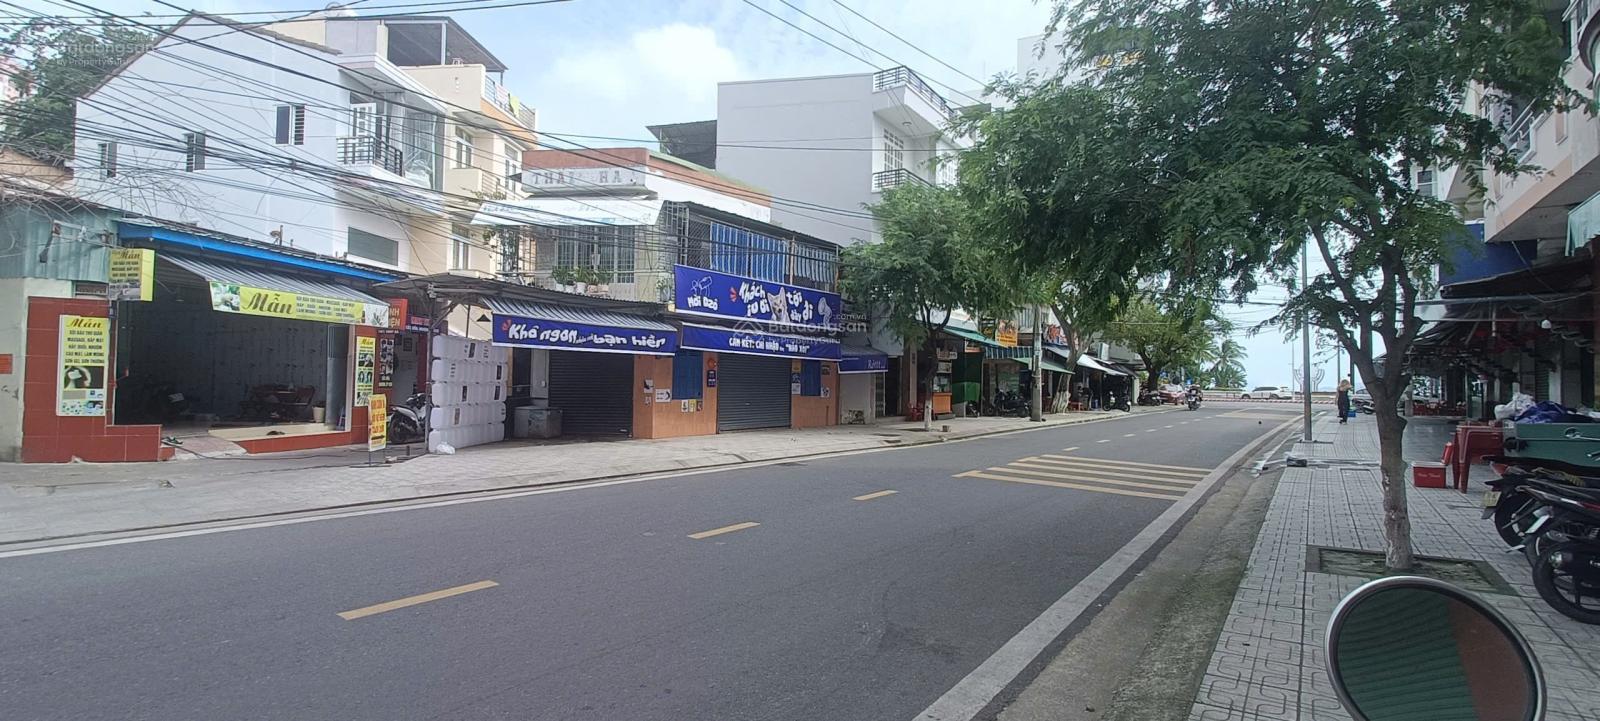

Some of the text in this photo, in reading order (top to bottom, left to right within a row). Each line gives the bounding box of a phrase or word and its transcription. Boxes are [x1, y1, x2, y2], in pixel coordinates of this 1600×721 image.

[242, 292, 293, 315] Mẫn
[739, 281, 766, 304] Khách
[508, 323, 539, 340] Khô
[539, 329, 578, 344] ngon
[593, 334, 628, 347] bạn
[631, 334, 666, 349] hiền
